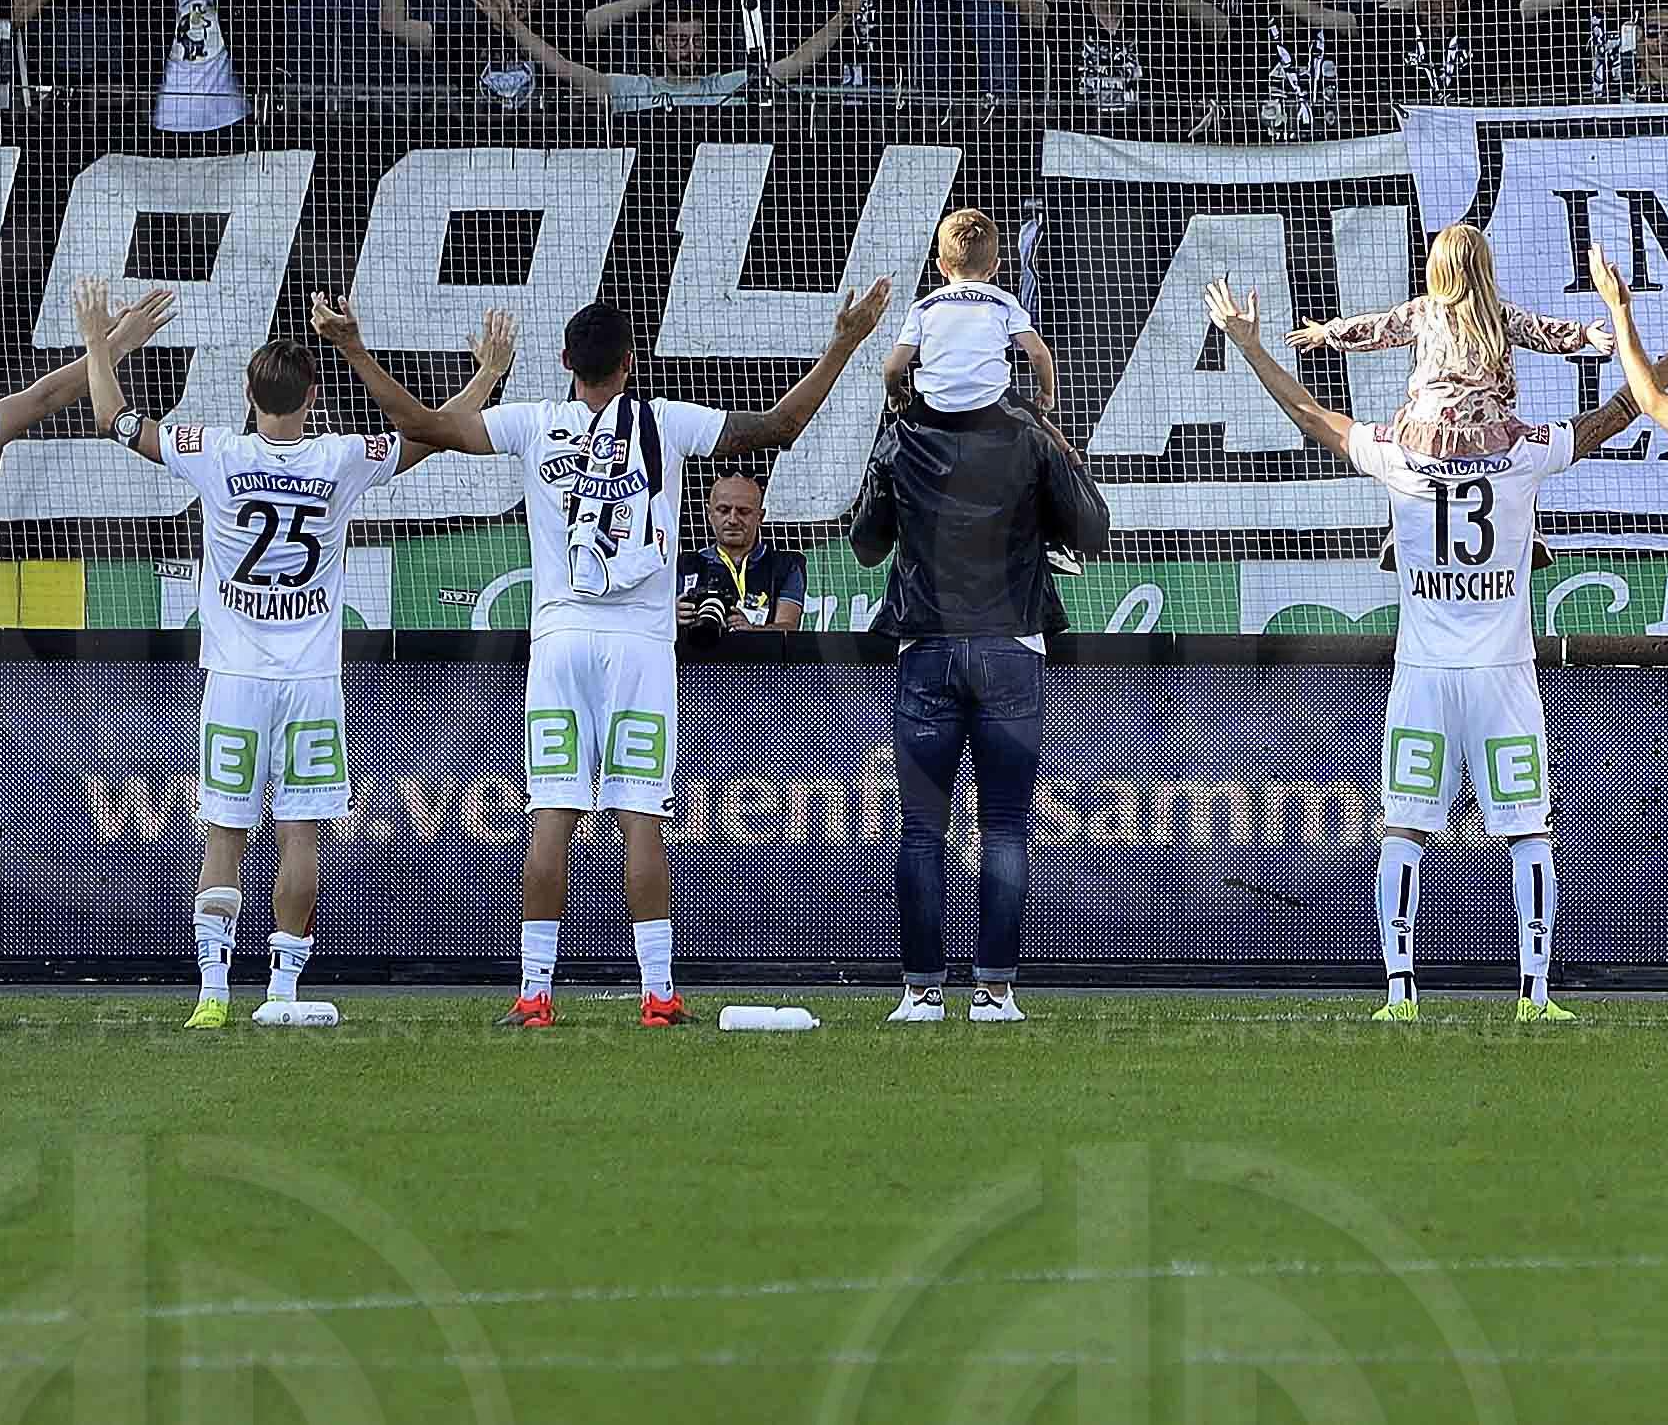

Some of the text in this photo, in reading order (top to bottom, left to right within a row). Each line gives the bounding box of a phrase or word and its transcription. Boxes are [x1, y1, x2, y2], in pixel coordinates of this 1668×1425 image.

[228, 473, 336, 498] PUNTIGAMER
[231, 499, 330, 587] 25
[1427, 475, 1496, 568] 13
[217, 581, 332, 623] HIERLÄNDER
